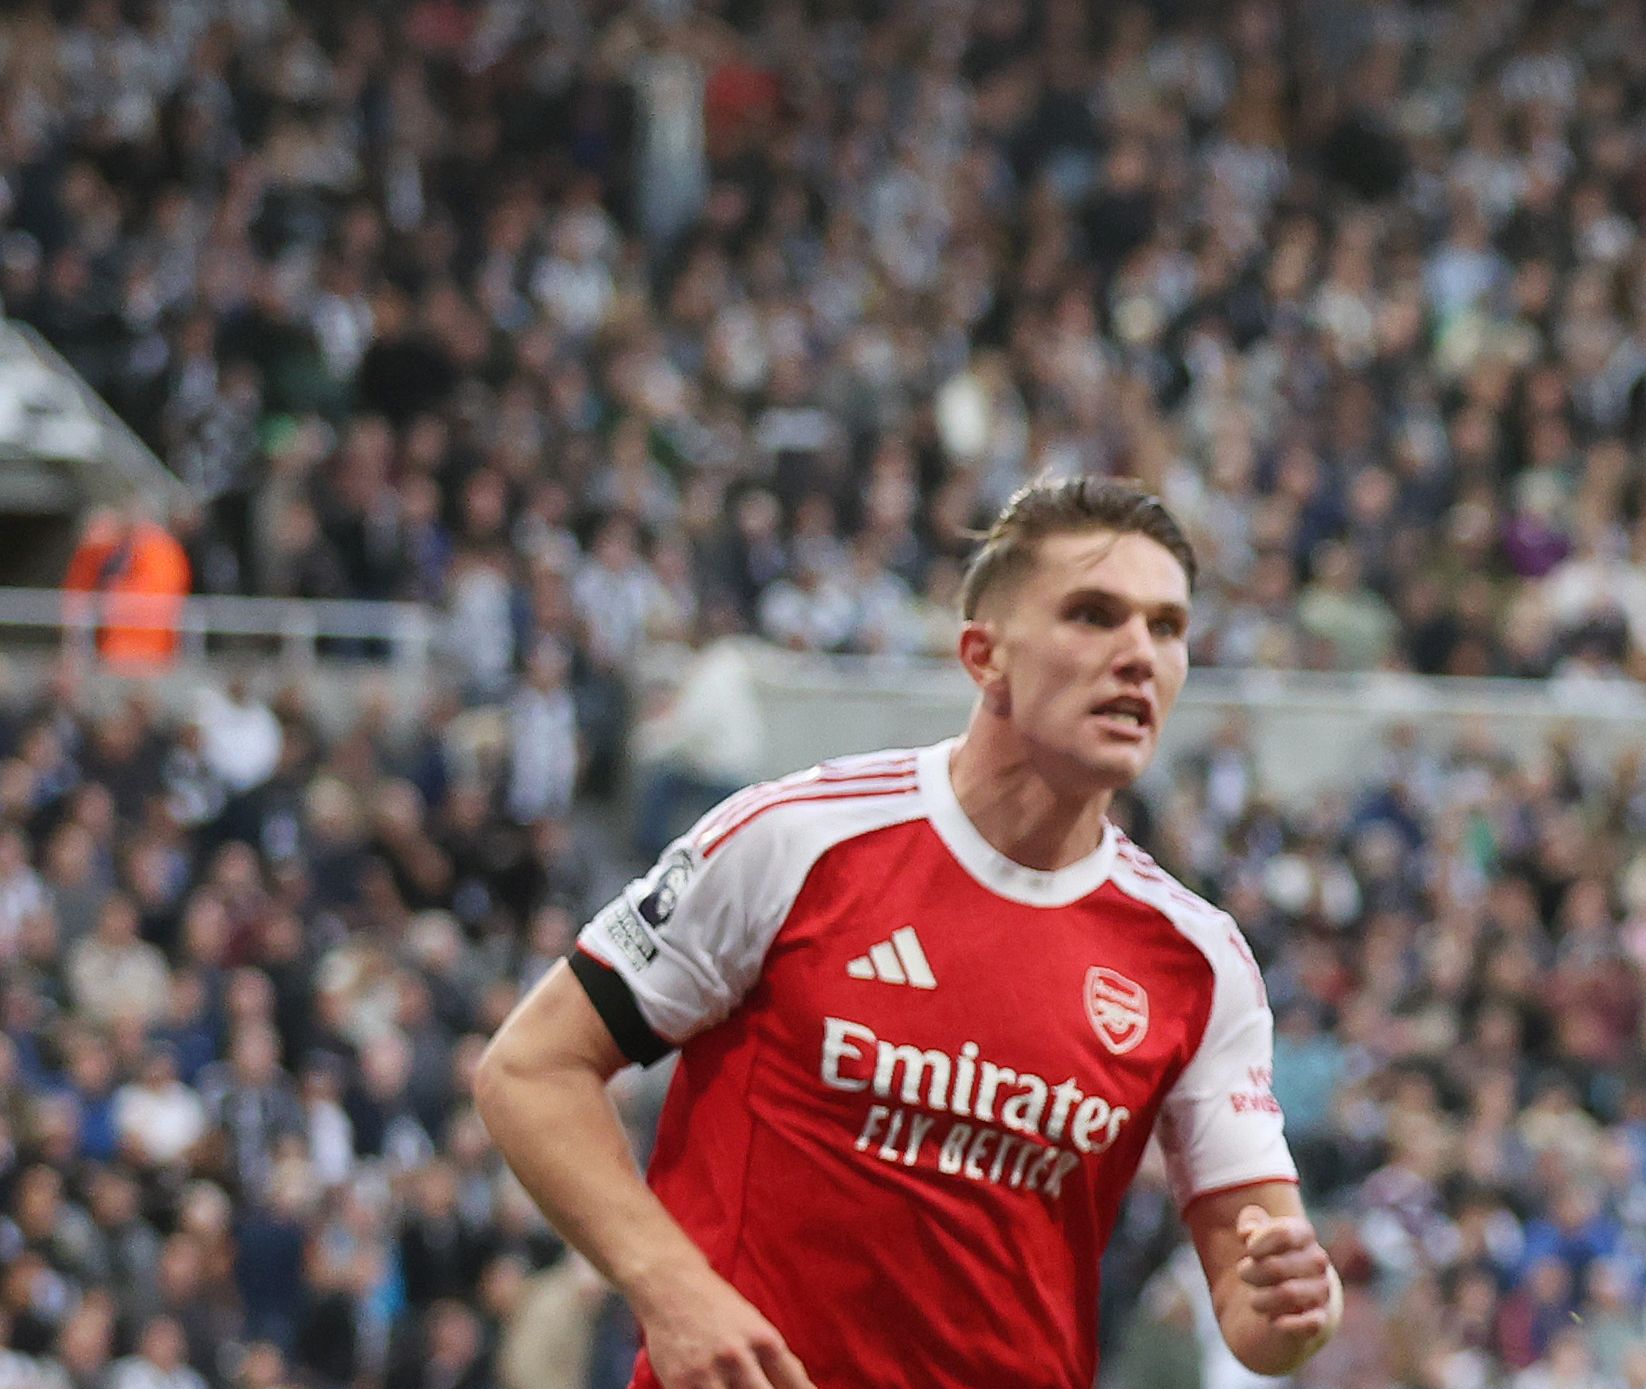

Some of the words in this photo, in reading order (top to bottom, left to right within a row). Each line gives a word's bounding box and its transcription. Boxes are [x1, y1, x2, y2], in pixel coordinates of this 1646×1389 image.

[821, 1016, 1131, 1154] Emirates
[854, 1104, 935, 1167] FLY
[938, 1122, 1080, 1201] BETTER
